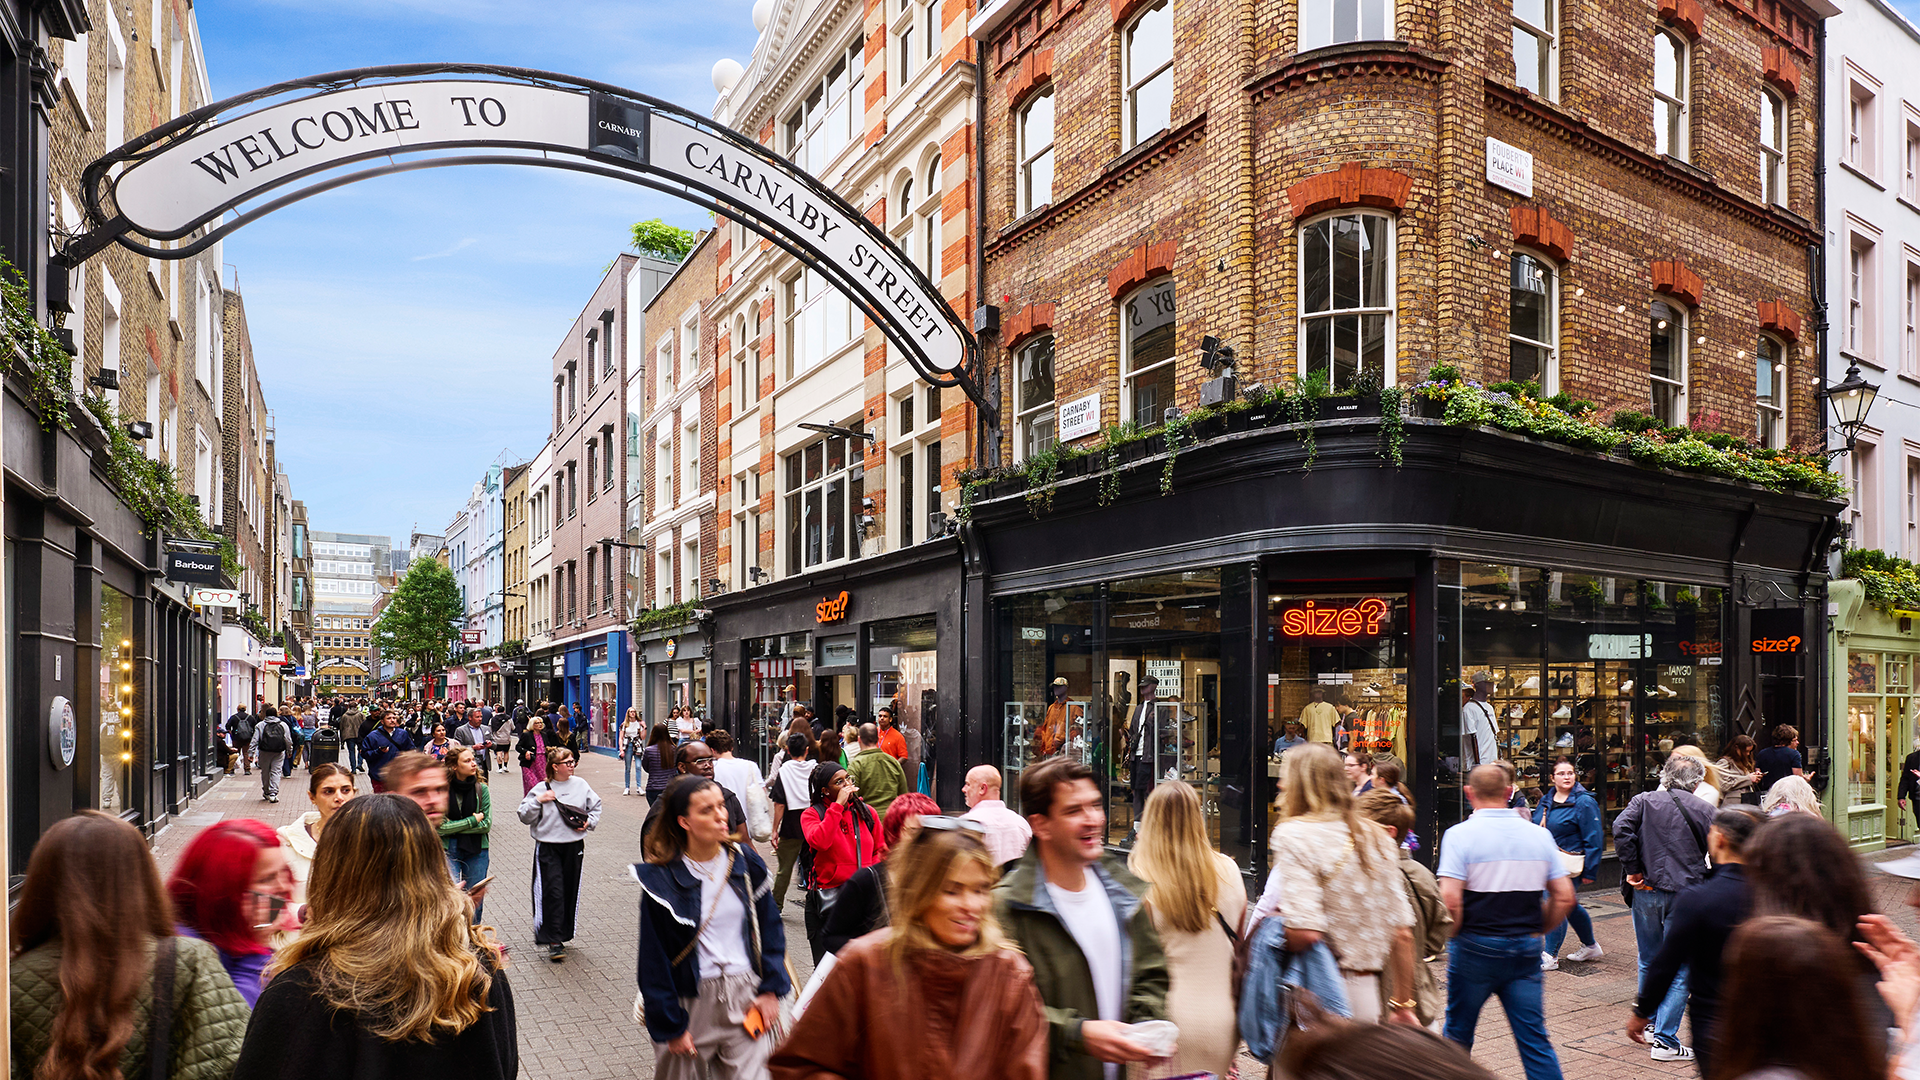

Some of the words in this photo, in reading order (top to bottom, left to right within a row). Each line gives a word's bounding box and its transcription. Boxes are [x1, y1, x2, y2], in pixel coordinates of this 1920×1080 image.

[598, 120, 642, 138] CARNABY
[1492, 142, 1529, 168] FOUBERT'S
[1492, 156, 1513, 175] PLACE
[1515, 166, 1525, 180] W1
[190, 99, 420, 185] WELCOME
[450, 96, 507, 127] TO
[684, 142, 841, 243] CARNABY
[848, 243, 943, 343] STREET
[1062, 399, 1091, 418] CARNABY
[1062, 413, 1084, 430] STREET
[1085, 410, 1095, 421] W1
[174, 559, 215, 571] Barbour
[815, 590, 849, 624] size?
[1282, 598, 1387, 636] size?
[1752, 635, 1801, 652] size?
[899, 655, 937, 685] SUPER
[1147, 669, 1158, 677] THE
[1160, 668, 1180, 677] SUMMER
[1165, 678, 1179, 686] WITH
[1352, 718, 1383, 727] Please
[1384, 719, 1401, 727] use
[1352, 729, 1367, 737] the
[1369, 729, 1393, 737] other
[1352, 740, 1394, 748] entrance.
